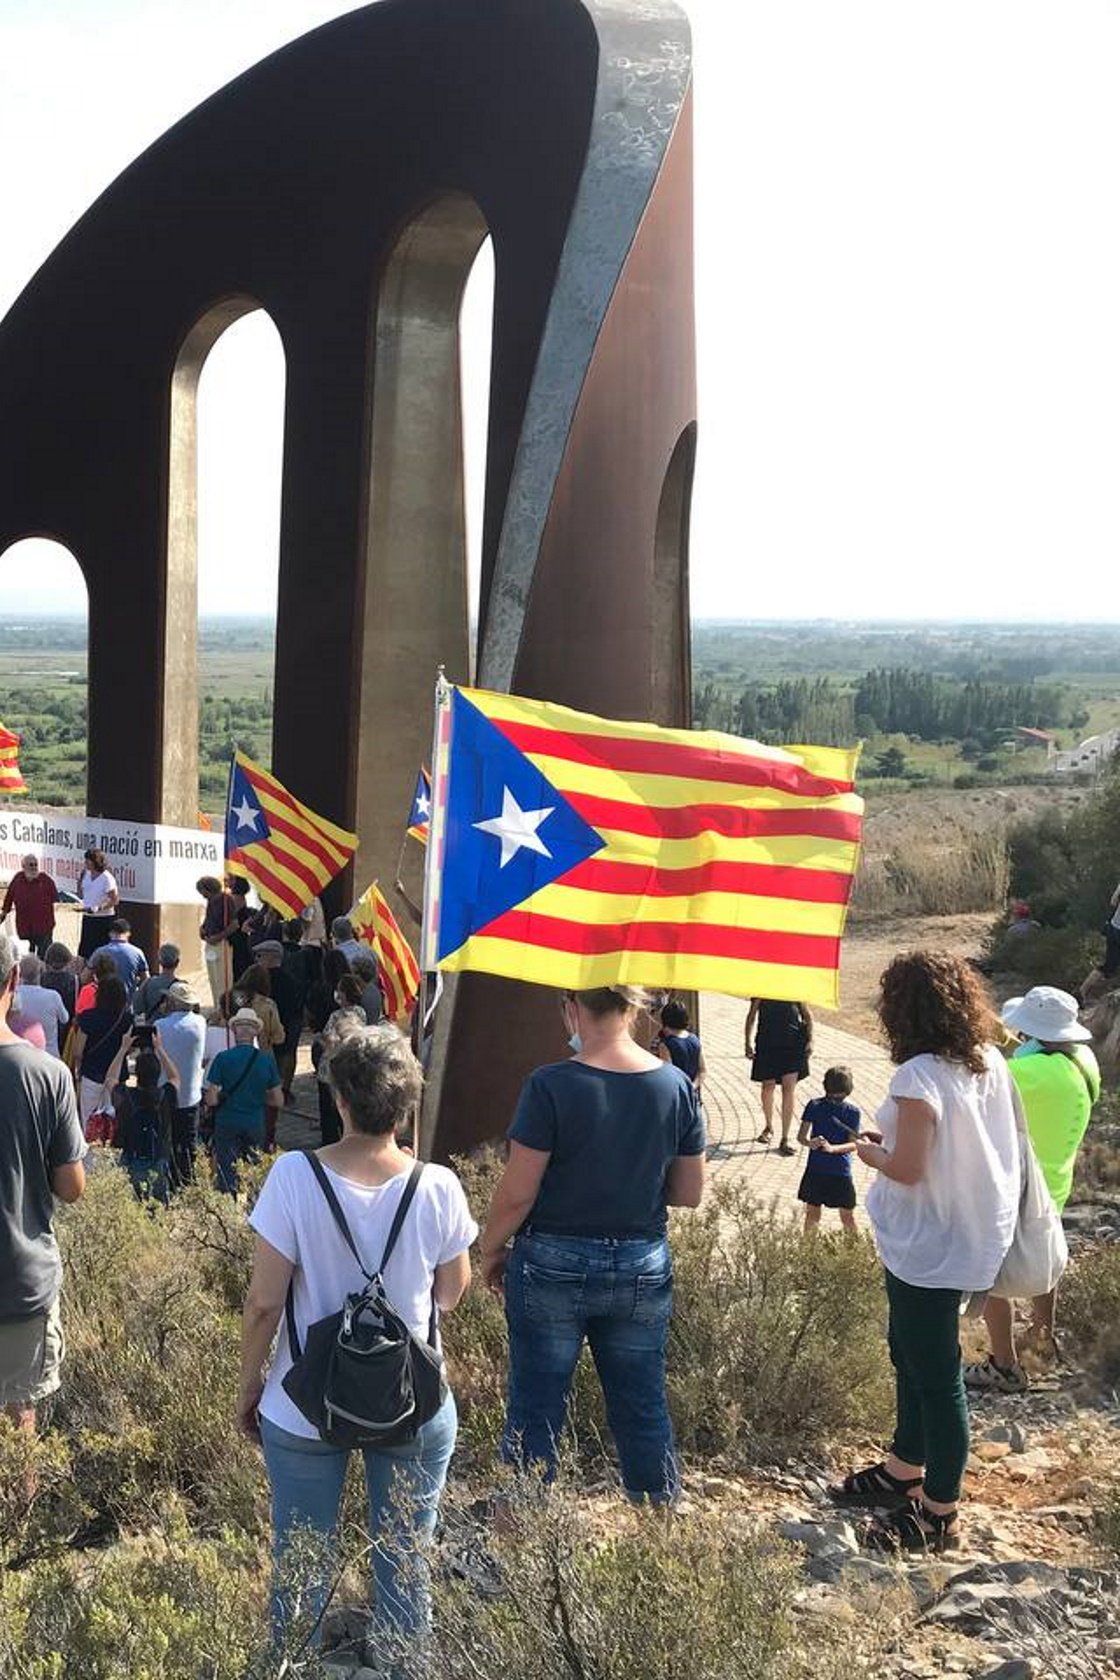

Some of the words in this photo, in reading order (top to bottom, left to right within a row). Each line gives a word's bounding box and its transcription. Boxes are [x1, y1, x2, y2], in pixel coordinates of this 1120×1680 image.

[12, 818, 74, 850] Catalans,
[76, 832, 97, 850] una
[101, 831, 139, 857] nació
[144, 839, 162, 857] en
[169, 840, 218, 861] marxa
